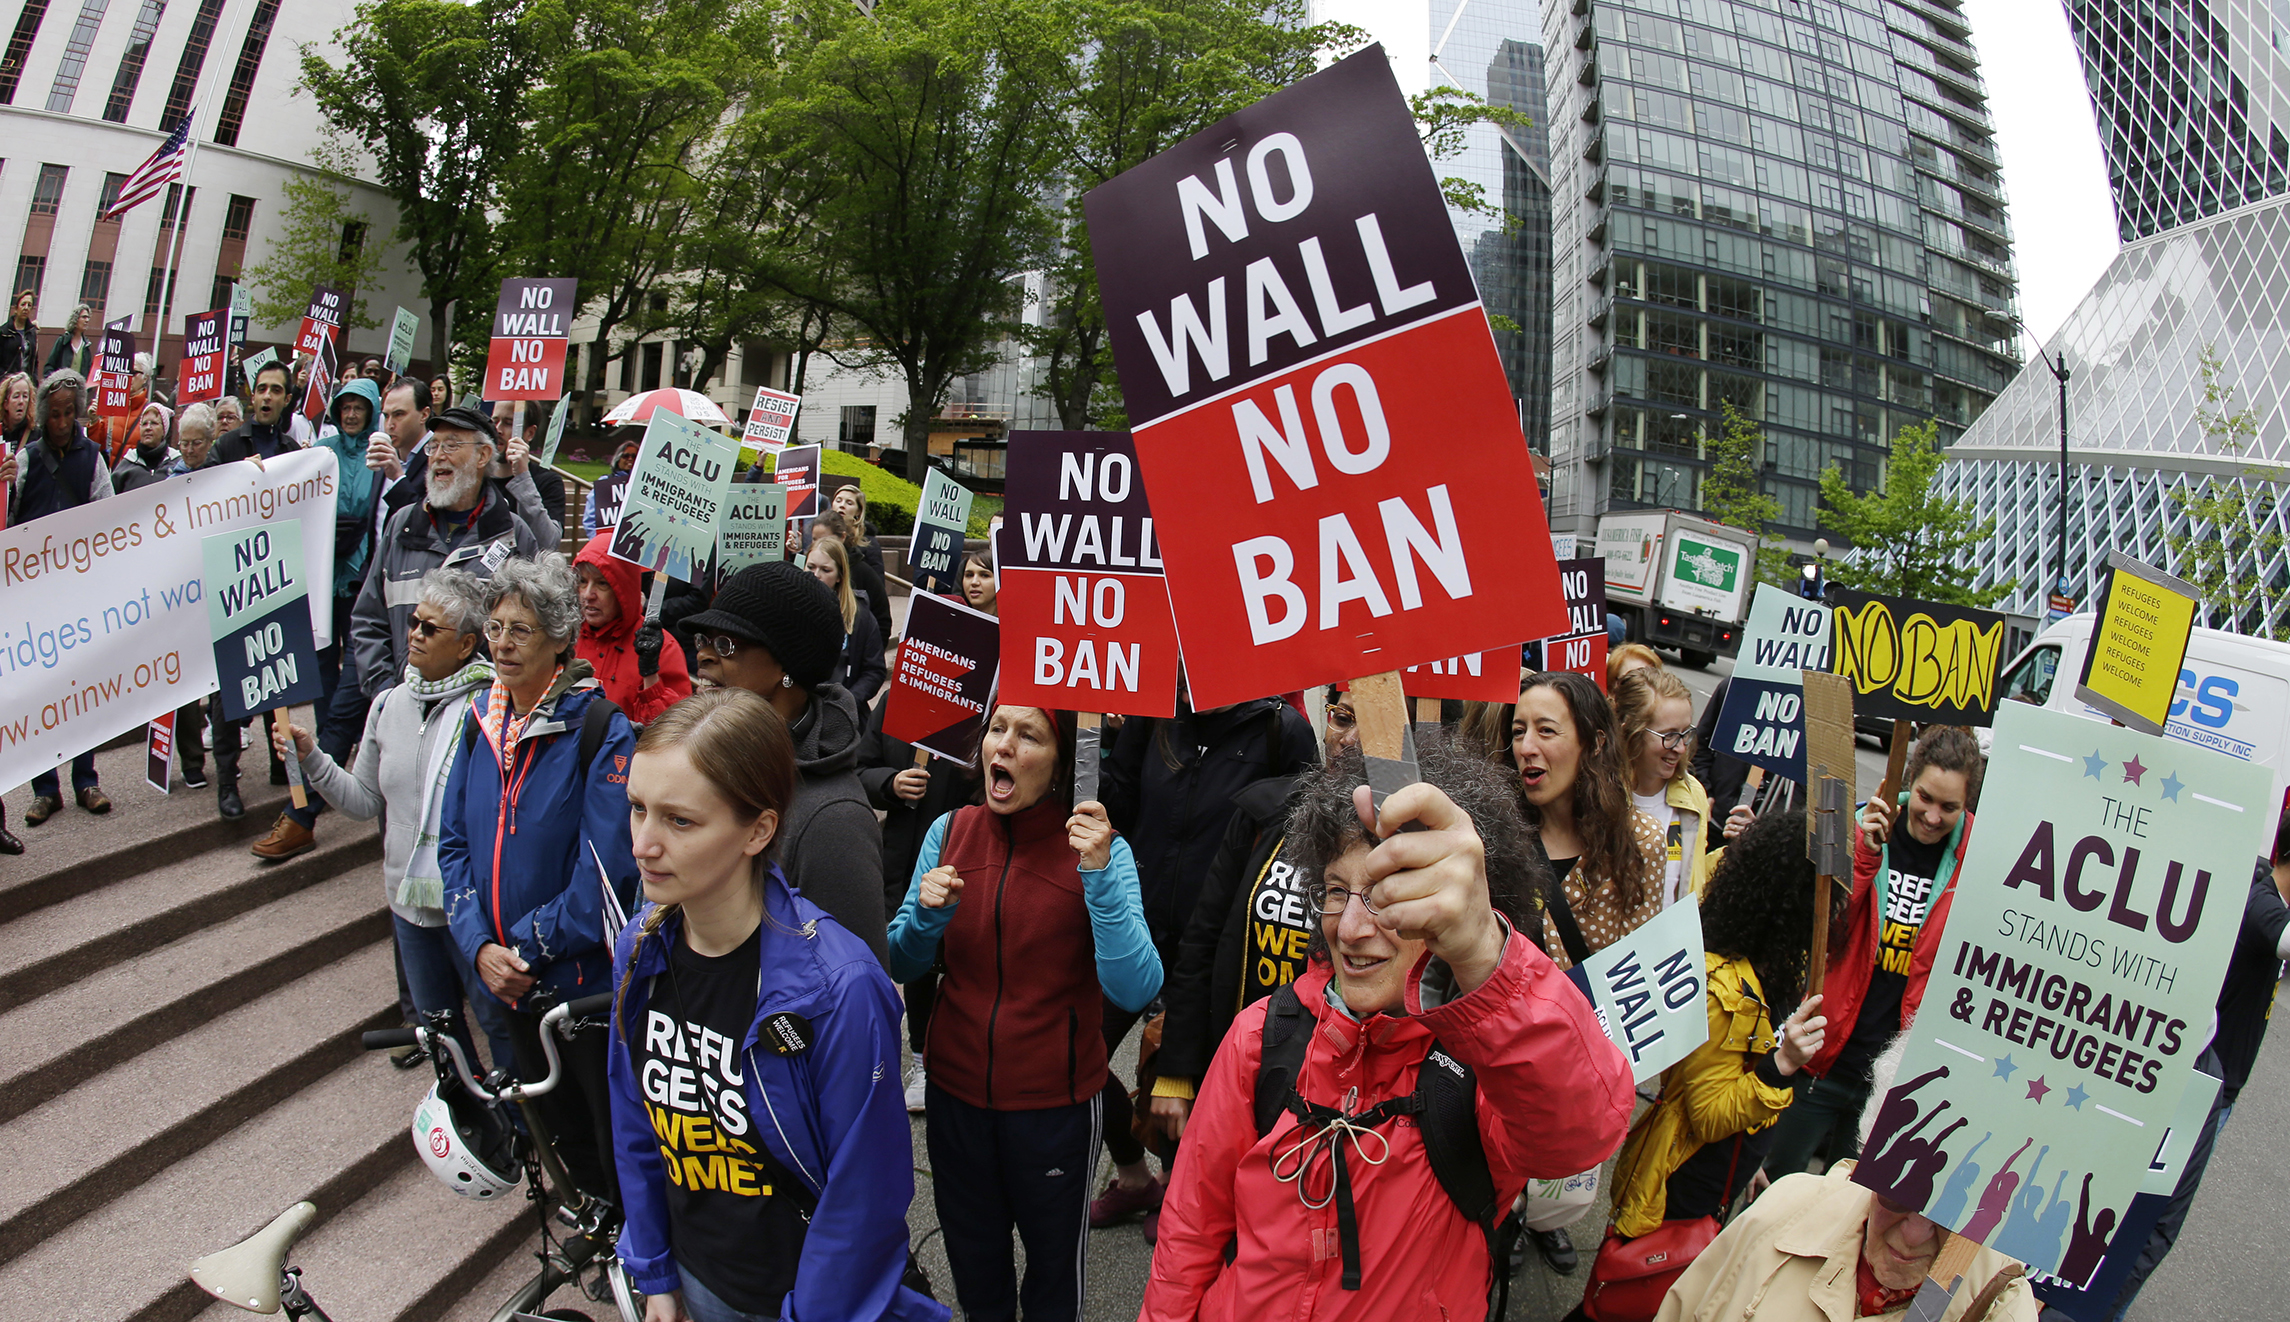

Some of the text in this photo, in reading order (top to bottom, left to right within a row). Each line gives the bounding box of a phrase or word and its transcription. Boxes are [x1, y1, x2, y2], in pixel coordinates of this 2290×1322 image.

[1176, 131, 1314, 261] NO
[238, 290, 247, 300] NO
[321, 292, 340, 308] NO
[520, 286, 553, 309] NO
[1135, 212, 1437, 398] WALL
[197, 320, 216, 338] NO
[233, 319, 243, 330] NO
[310, 304, 340, 325] WALL
[311, 321, 328, 336] NO
[502, 313, 562, 336] WALL
[108, 338, 122, 354] NO
[188, 337, 221, 358] WALL
[230, 331, 243, 343] BAN
[302, 335, 319, 351] BA
[511, 339, 544, 363] NO
[105, 356, 131, 374] WALL
[193, 356, 212, 374] NO
[253, 352, 267, 367] NO
[115, 375, 129, 390] NO
[188, 373, 214, 393] BAN
[499, 367, 549, 391] BAN
[107, 392, 127, 407] BAN
[761, 412, 783, 425] AND
[1231, 362, 1391, 504] NO
[686, 438, 703, 453] THE
[656, 441, 721, 482] ACLU
[778, 465, 810, 475] AMERICANS
[641, 471, 717, 514] IMMIGRANTS
[654, 463, 713, 496] STANDS WITH
[940, 482, 960, 502] NO
[1059, 451, 1132, 504] NO
[641, 485, 711, 524] & REFUGEES
[729, 505, 778, 520] ACLU
[929, 499, 963, 524] WALL
[4, 470, 334, 588] Refugees & Immigrants
[723, 532, 780, 541] IMMIGRANTS
[730, 522, 775, 530] STANDS WITH
[930, 531, 951, 551] NO
[1021, 512, 1164, 569] WALL
[234, 530, 272, 574] NO
[725, 541, 778, 549] & REFUGEES
[920, 550, 951, 573] BAN
[1231, 483, 1473, 647] BAN
[219, 558, 295, 619] WALL
[1562, 570, 1588, 600] NO
[2121, 584, 2161, 609] REFUGEES
[1054, 575, 1126, 629] NO
[2118, 600, 2159, 625] WELCOME
[0, 616, 93, 678] ridges
[102, 587, 151, 634] not
[1567, 604, 1602, 637] ALL
[1781, 606, 1824, 639] NO
[2114, 615, 2154, 641] REFUGEES
[244, 621, 284, 668] NO
[904, 649, 927, 667] FOR
[906, 636, 977, 672] AMERICANS
[1566, 639, 1590, 670] NO
[1833, 600, 2004, 713] NO BAN
[2106, 646, 2146, 672] REFUGEES
[2110, 631, 2151, 657] WELCOME
[901, 661, 963, 693] REFUGEES
[1034, 636, 1141, 693] BAN
[2102, 661, 2143, 688] WELCOME
[241, 652, 299, 710] BAN
[899, 673, 984, 715] & IMMIGRANTS
[0, 650, 180, 750] w.arinw.org
[1754, 690, 1801, 724] NO
[1733, 723, 1801, 760] BAN
[2192, 731, 2231, 750] SUPPLY
[2232, 743, 2253, 759] INC.
[2102, 795, 2153, 839] THE
[2002, 820, 2212, 943] ACLU
[1998, 909, 2178, 995] STANDS WITH
[1652, 948, 1700, 1014] NO
[1605, 950, 1666, 1067] WALL
[1952, 940, 2187, 1056] IMMIGRANTS
[772, 1019, 799, 1052] WELCOME
[778, 1015, 806, 1050] REFUGEES
[1949, 986, 2163, 1095] & REFUGEES
[645, 1009, 744, 1087] REFU
[641, 1059, 748, 1137] GEES
[659, 1145, 773, 1196] OME.
